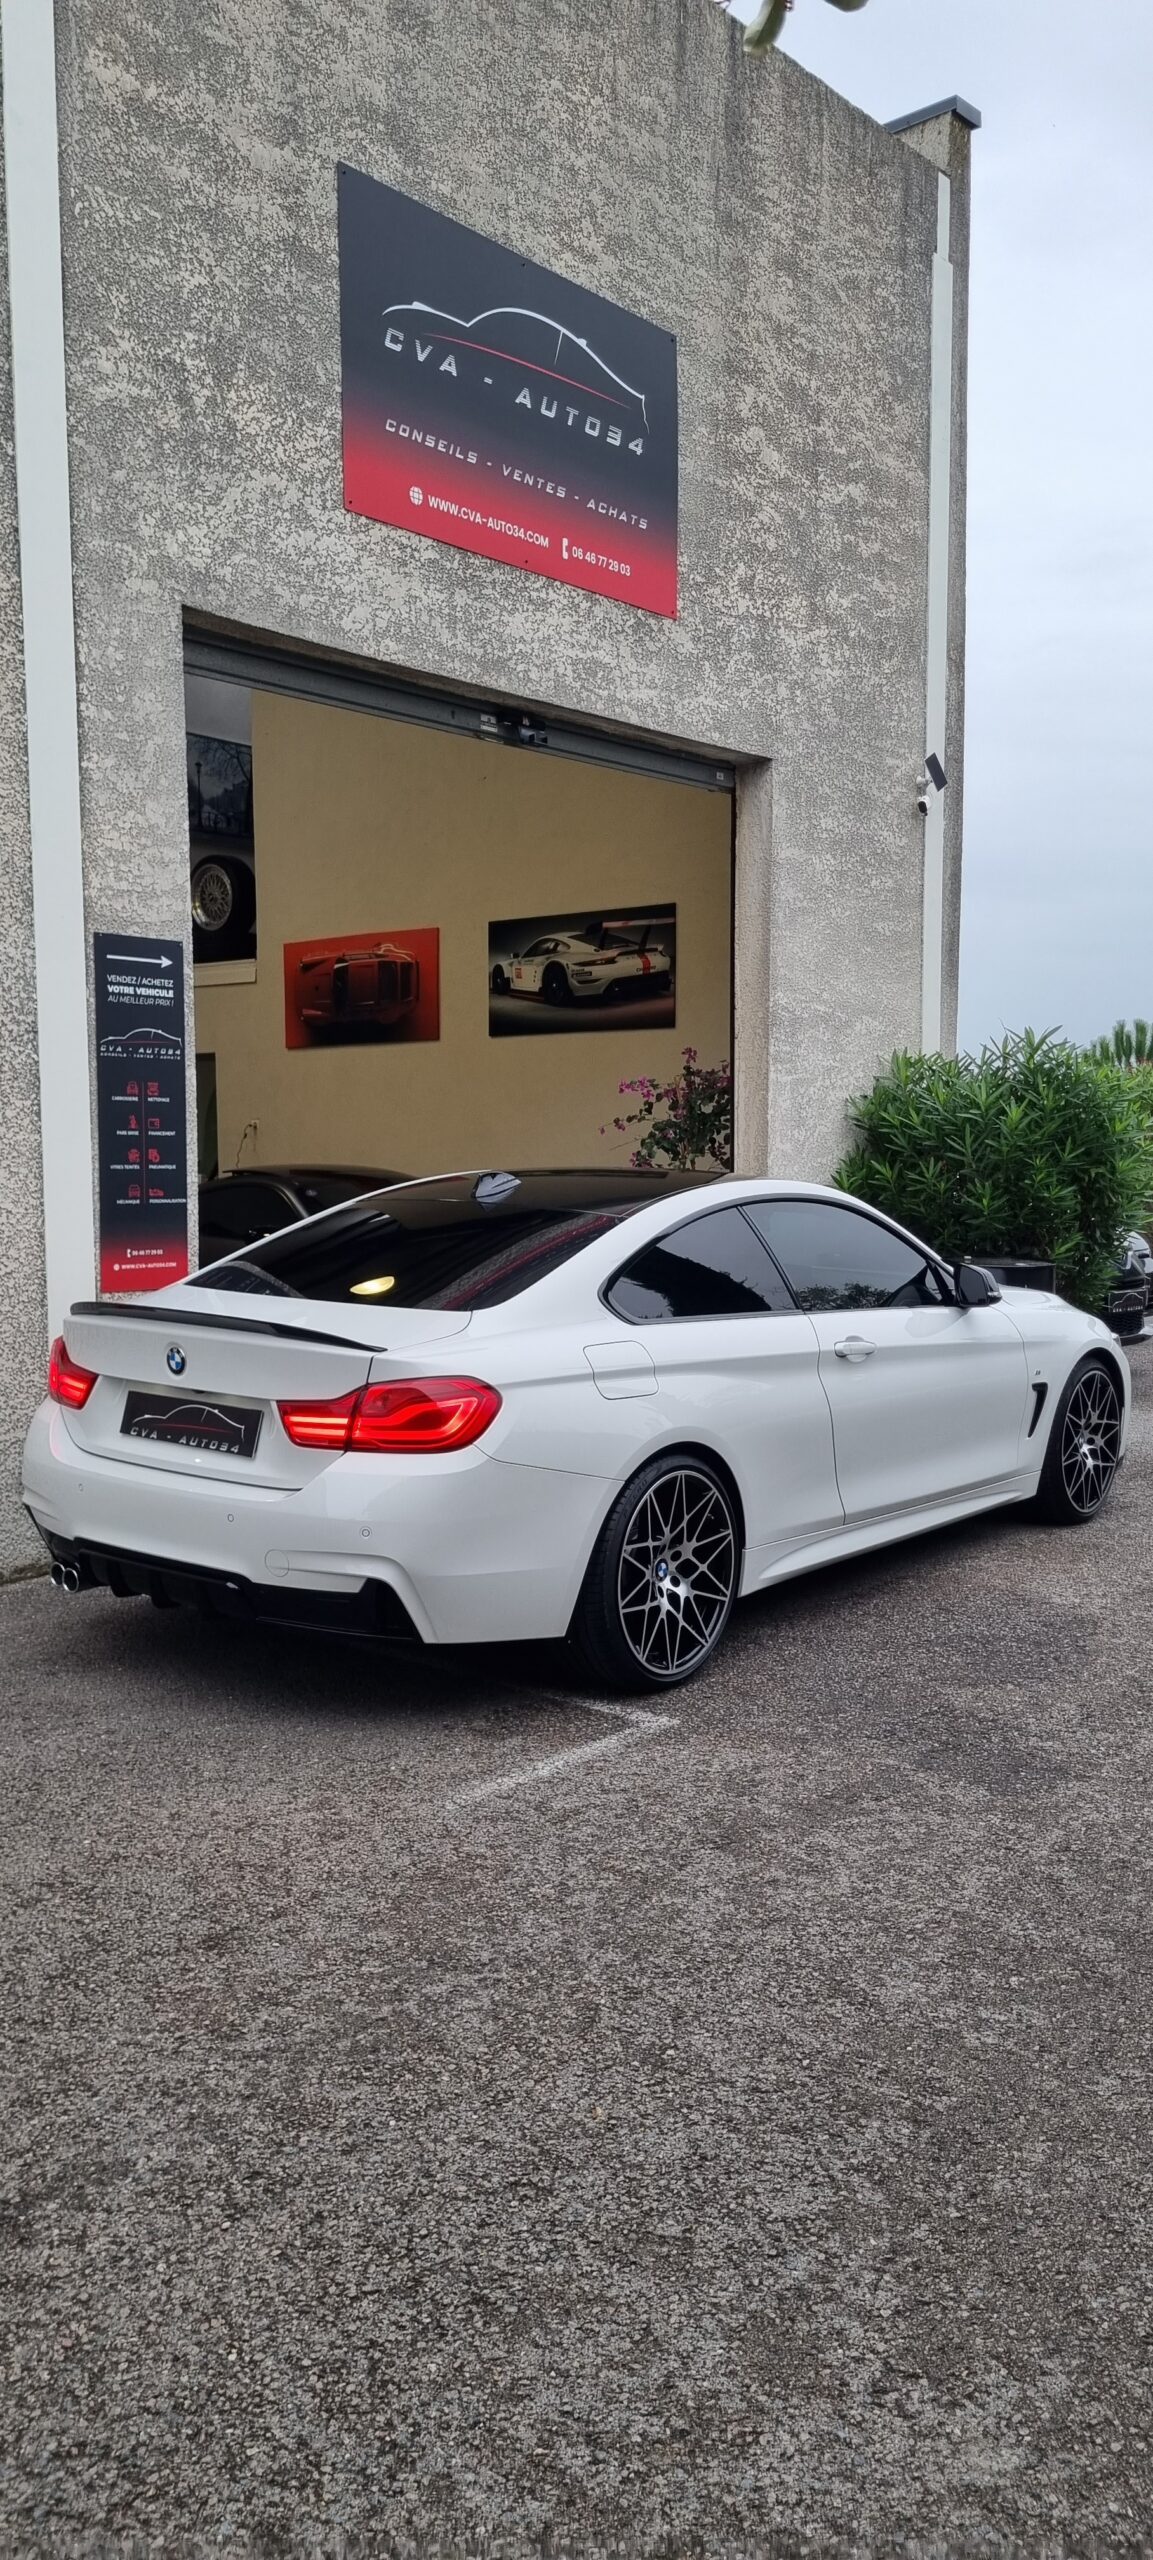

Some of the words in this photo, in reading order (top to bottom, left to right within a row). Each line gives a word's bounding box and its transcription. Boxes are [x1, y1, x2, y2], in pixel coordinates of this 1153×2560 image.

[384, 327, 457, 377] CVA
[515, 387, 644, 456] AUTO34
[385, 418, 478, 464] CONSEILS
[502, 463, 567, 498] VENTES
[586, 498, 648, 530] ACHATS
[427, 494, 550, 549] WWW.CVA-AUTO34.COM
[571, 546, 584, 560] 06
[585, 551, 597, 565] 46
[598, 555, 607, 568] 77
[608, 559, 619, 573] 29
[620, 563, 631, 577] 03
[107, 974, 136, 984] VENDEZ
[142, 977, 174, 987] ACHETEZ
[107, 985, 135, 995] VOTRE
[136, 986, 174, 998] VEHICULE
[107, 994, 119, 1003] AU
[119, 995, 155, 1006] MEILLEUR
[130, 1426, 158, 1439] CVA
[178, 1436, 240, 1453] AUTO34
